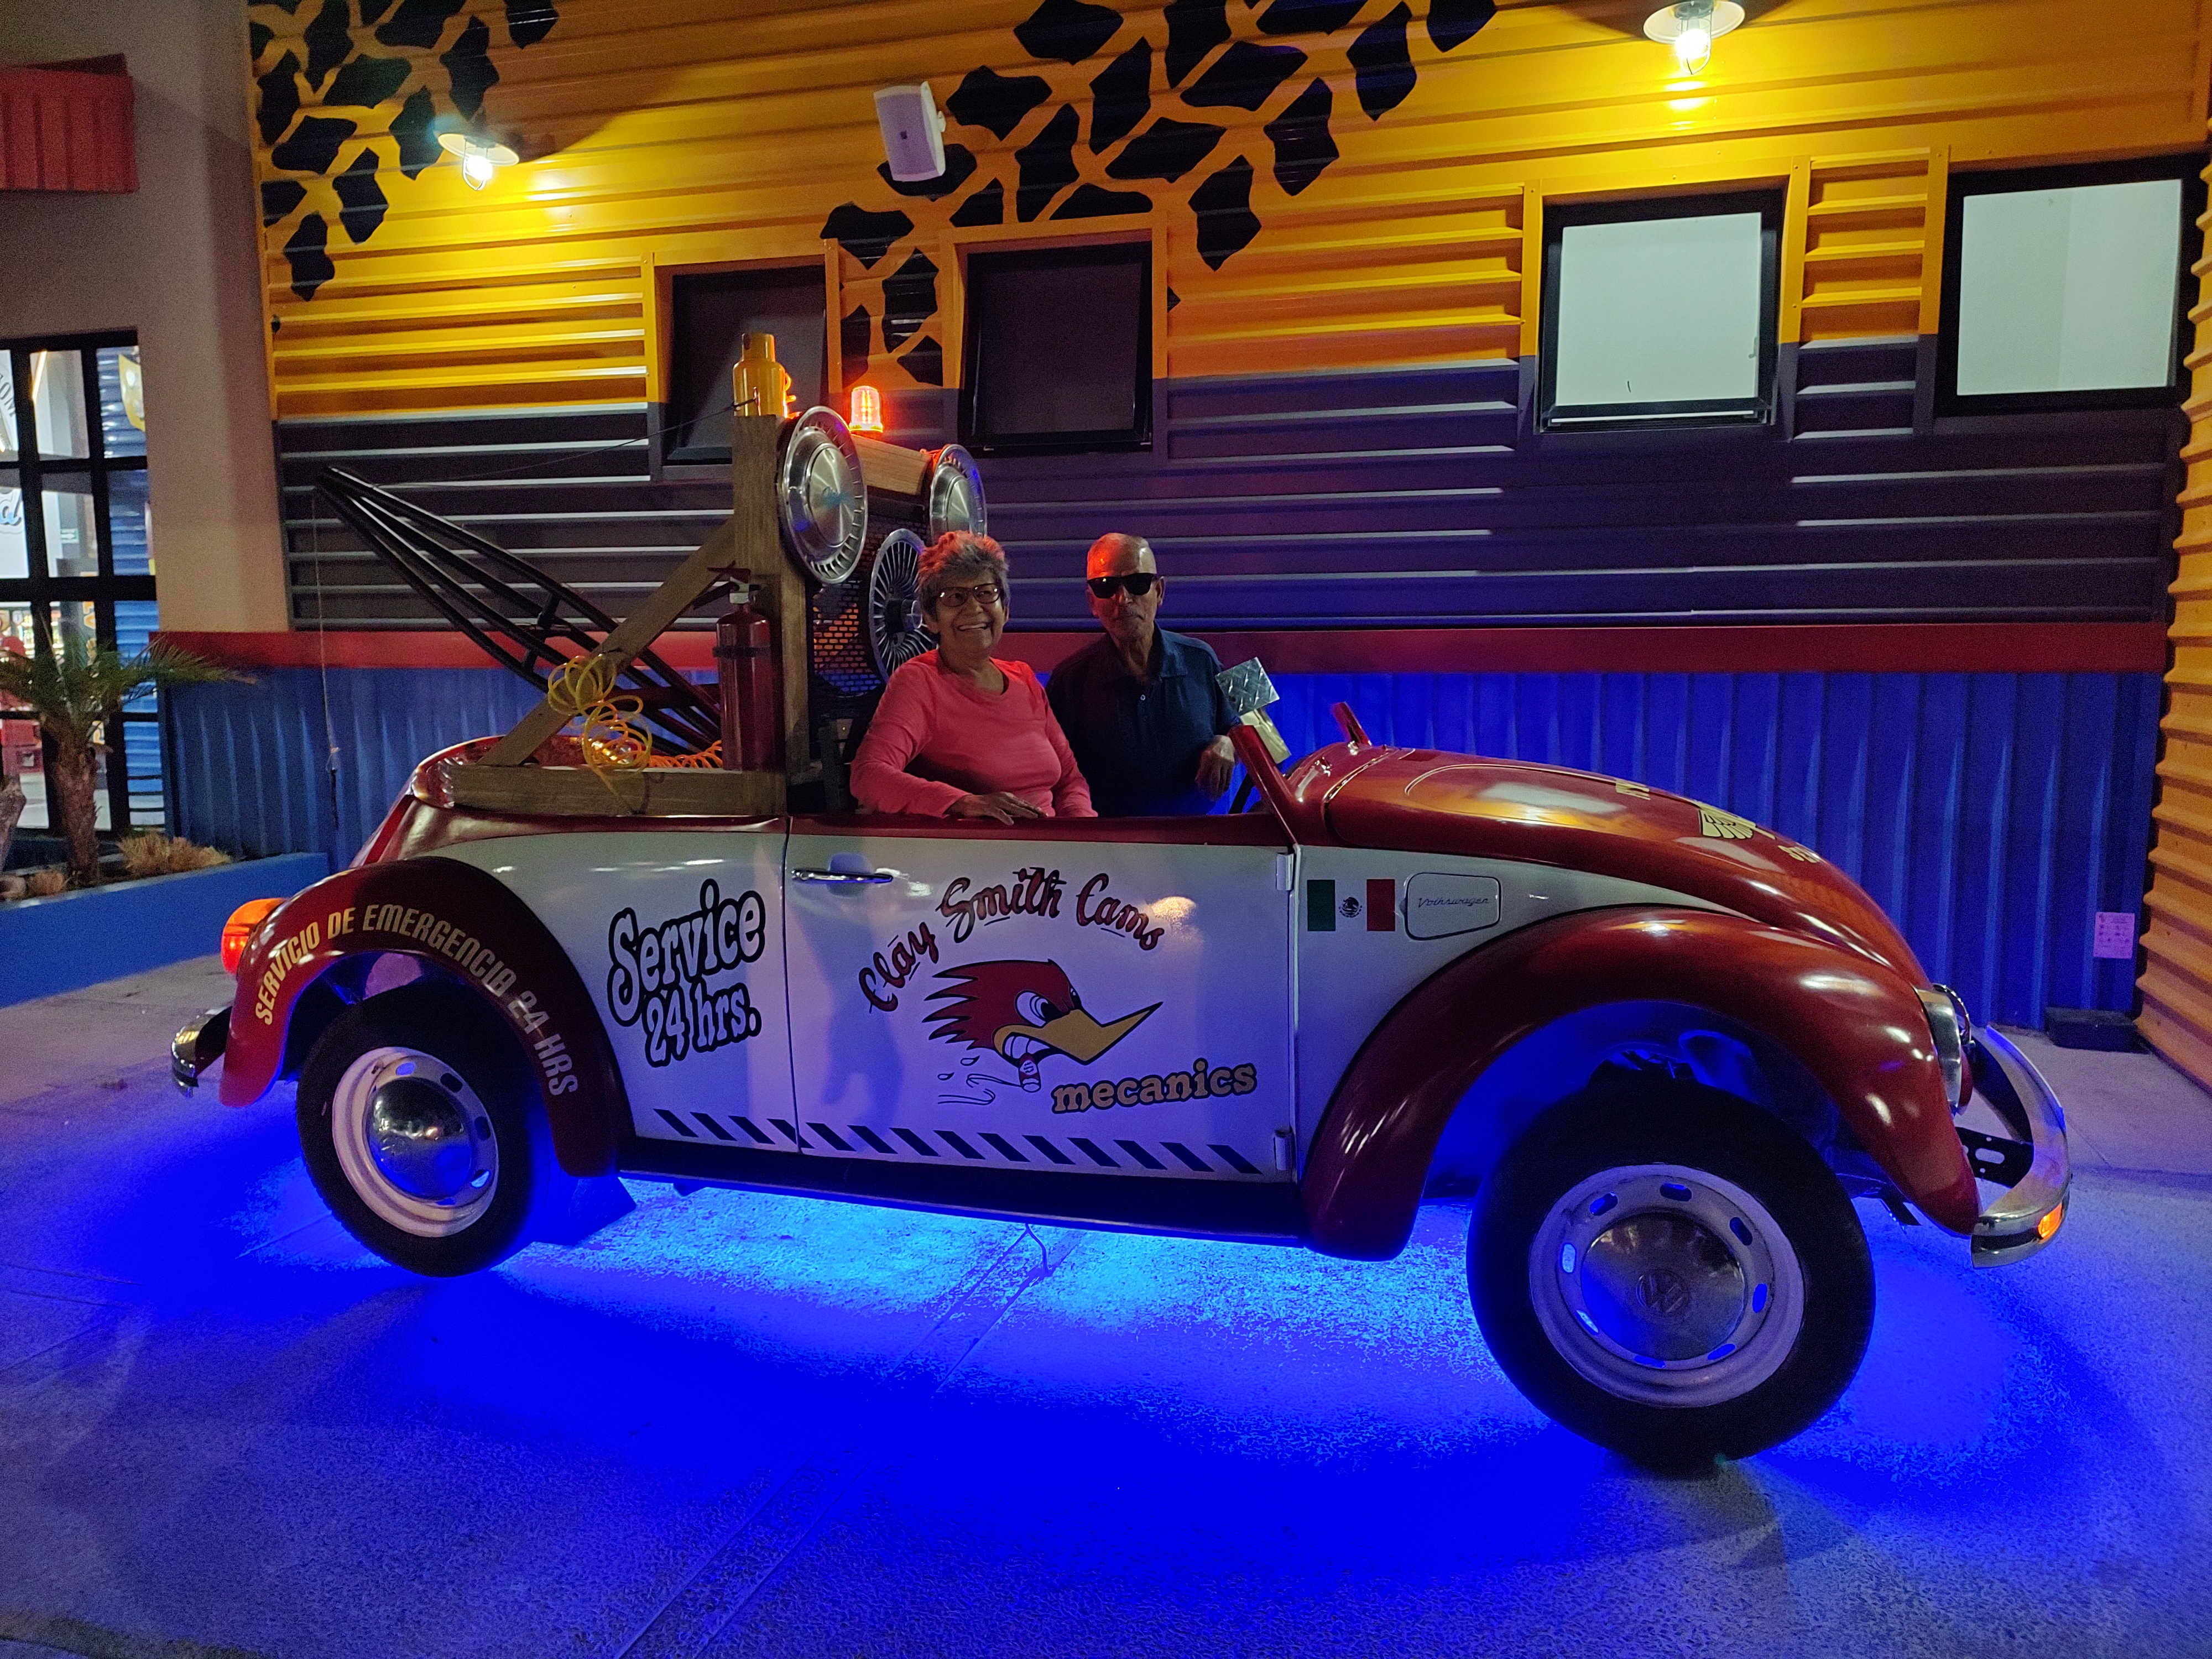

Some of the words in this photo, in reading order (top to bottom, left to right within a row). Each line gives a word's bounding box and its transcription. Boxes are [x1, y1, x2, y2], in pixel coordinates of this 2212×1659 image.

[255, 921, 320, 1025] SERVICIO
[327, 907, 356, 940] DE
[363, 904, 517, 997] EMERGENCIA
[507, 990, 550, 1035] 24
[534, 1034, 578, 1096] HRS
[607, 878, 766, 1027] Service
[859, 922, 939, 1013] Clay
[936, 867, 1067, 943] Smith
[1076, 873, 1165, 951] Cams
[641, 983, 691, 1068] 24
[689, 977, 762, 1053] hrs.
[1051, 1058, 1258, 1114] mecanics
